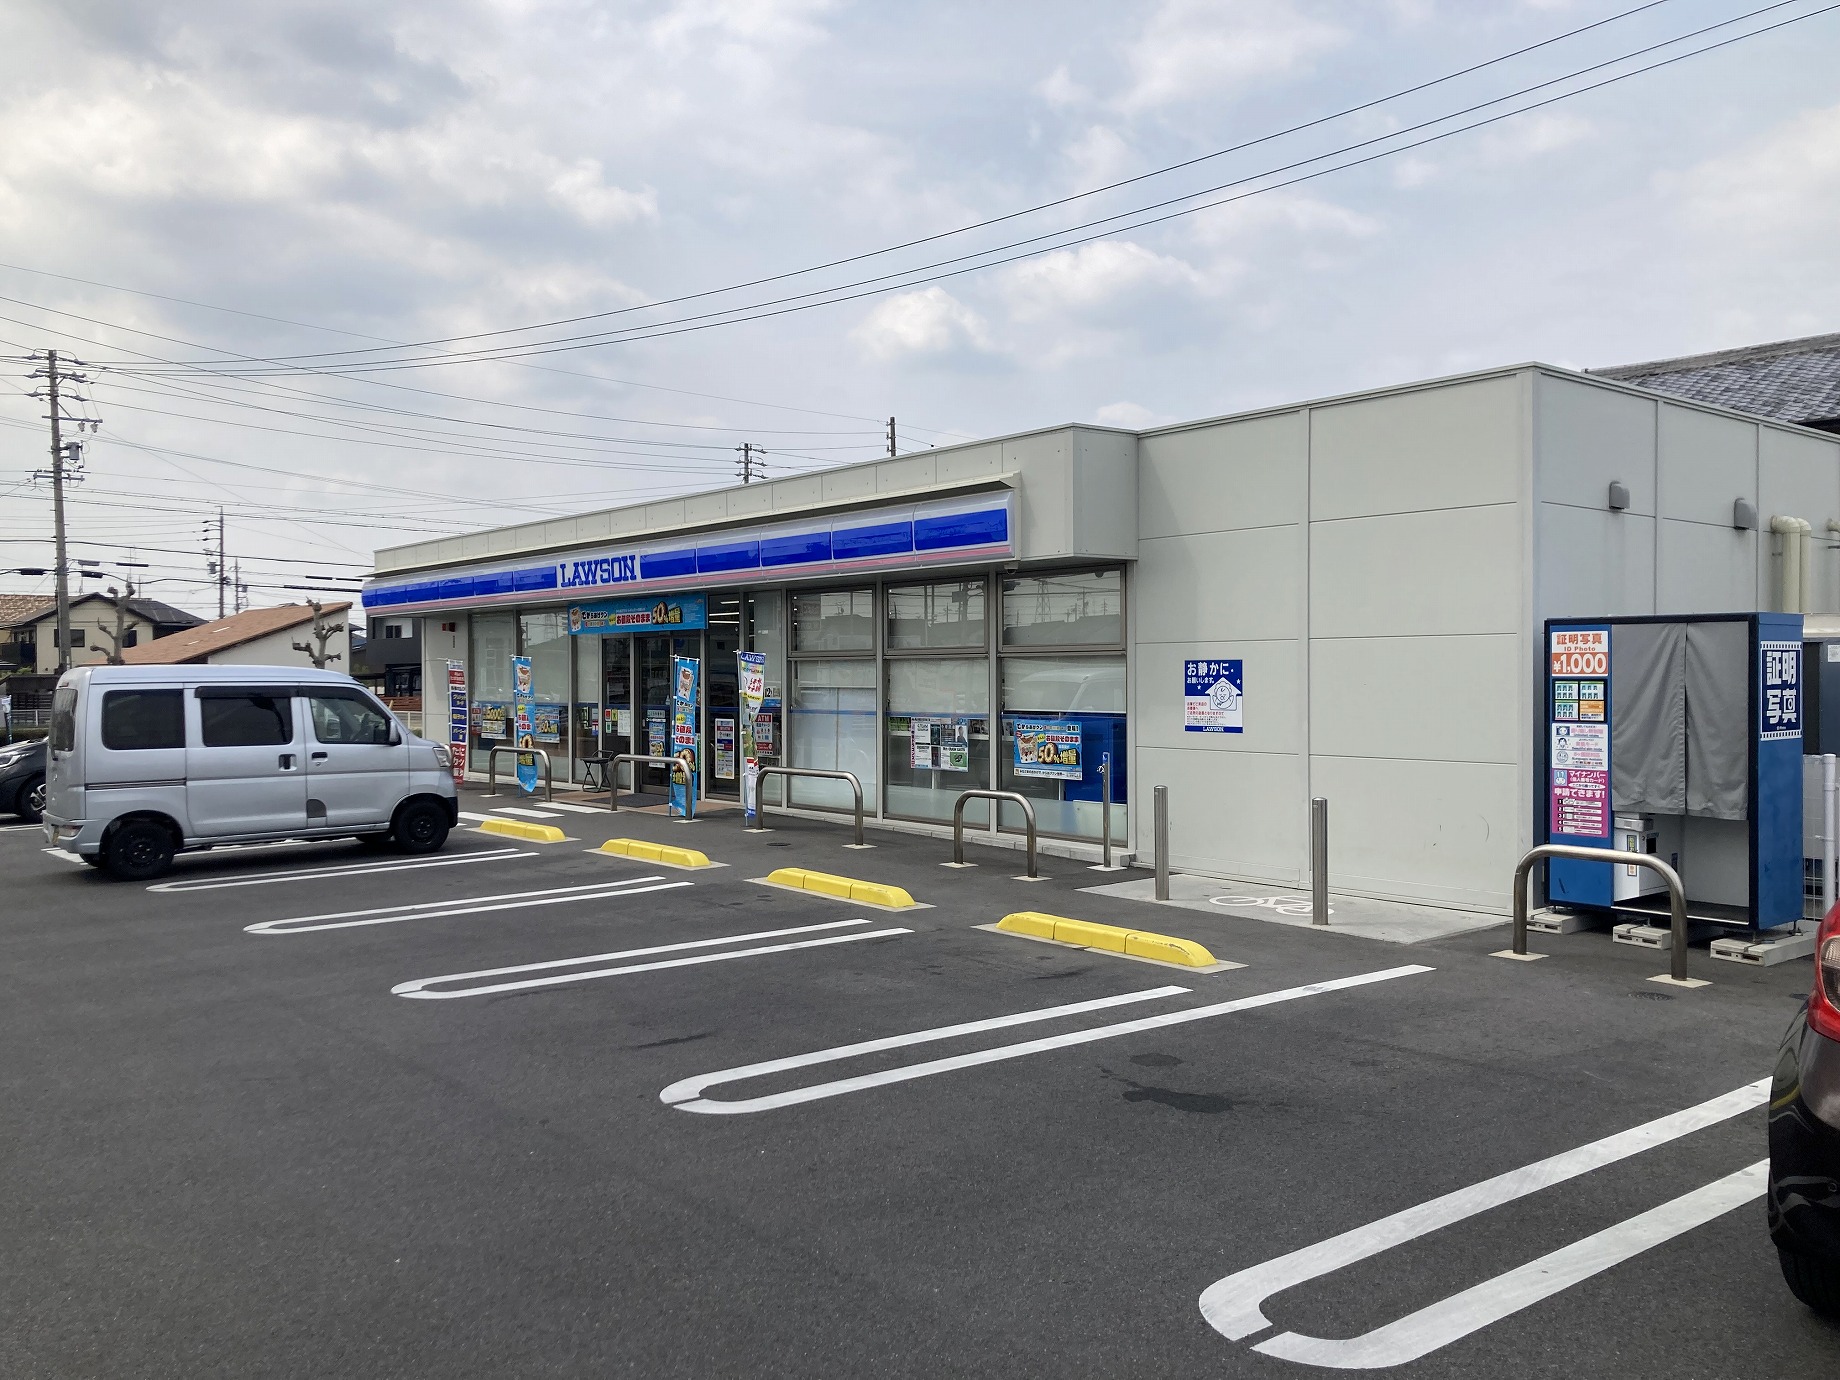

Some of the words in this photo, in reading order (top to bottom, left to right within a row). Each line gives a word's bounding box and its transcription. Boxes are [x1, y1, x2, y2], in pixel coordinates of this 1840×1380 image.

[560, 555, 636, 588] LAWSON
[1556, 633, 1603, 645] 証明写真
[1553, 653, 1607, 674] ¥1,000
[1766, 651, 1797, 686] 証明
[1766, 687, 1797, 725] 写真
[757, 714, 770, 722] ATM
[1568, 770, 1606, 778] マイナンバー
[1554, 788, 1606, 799] 申請できます!
